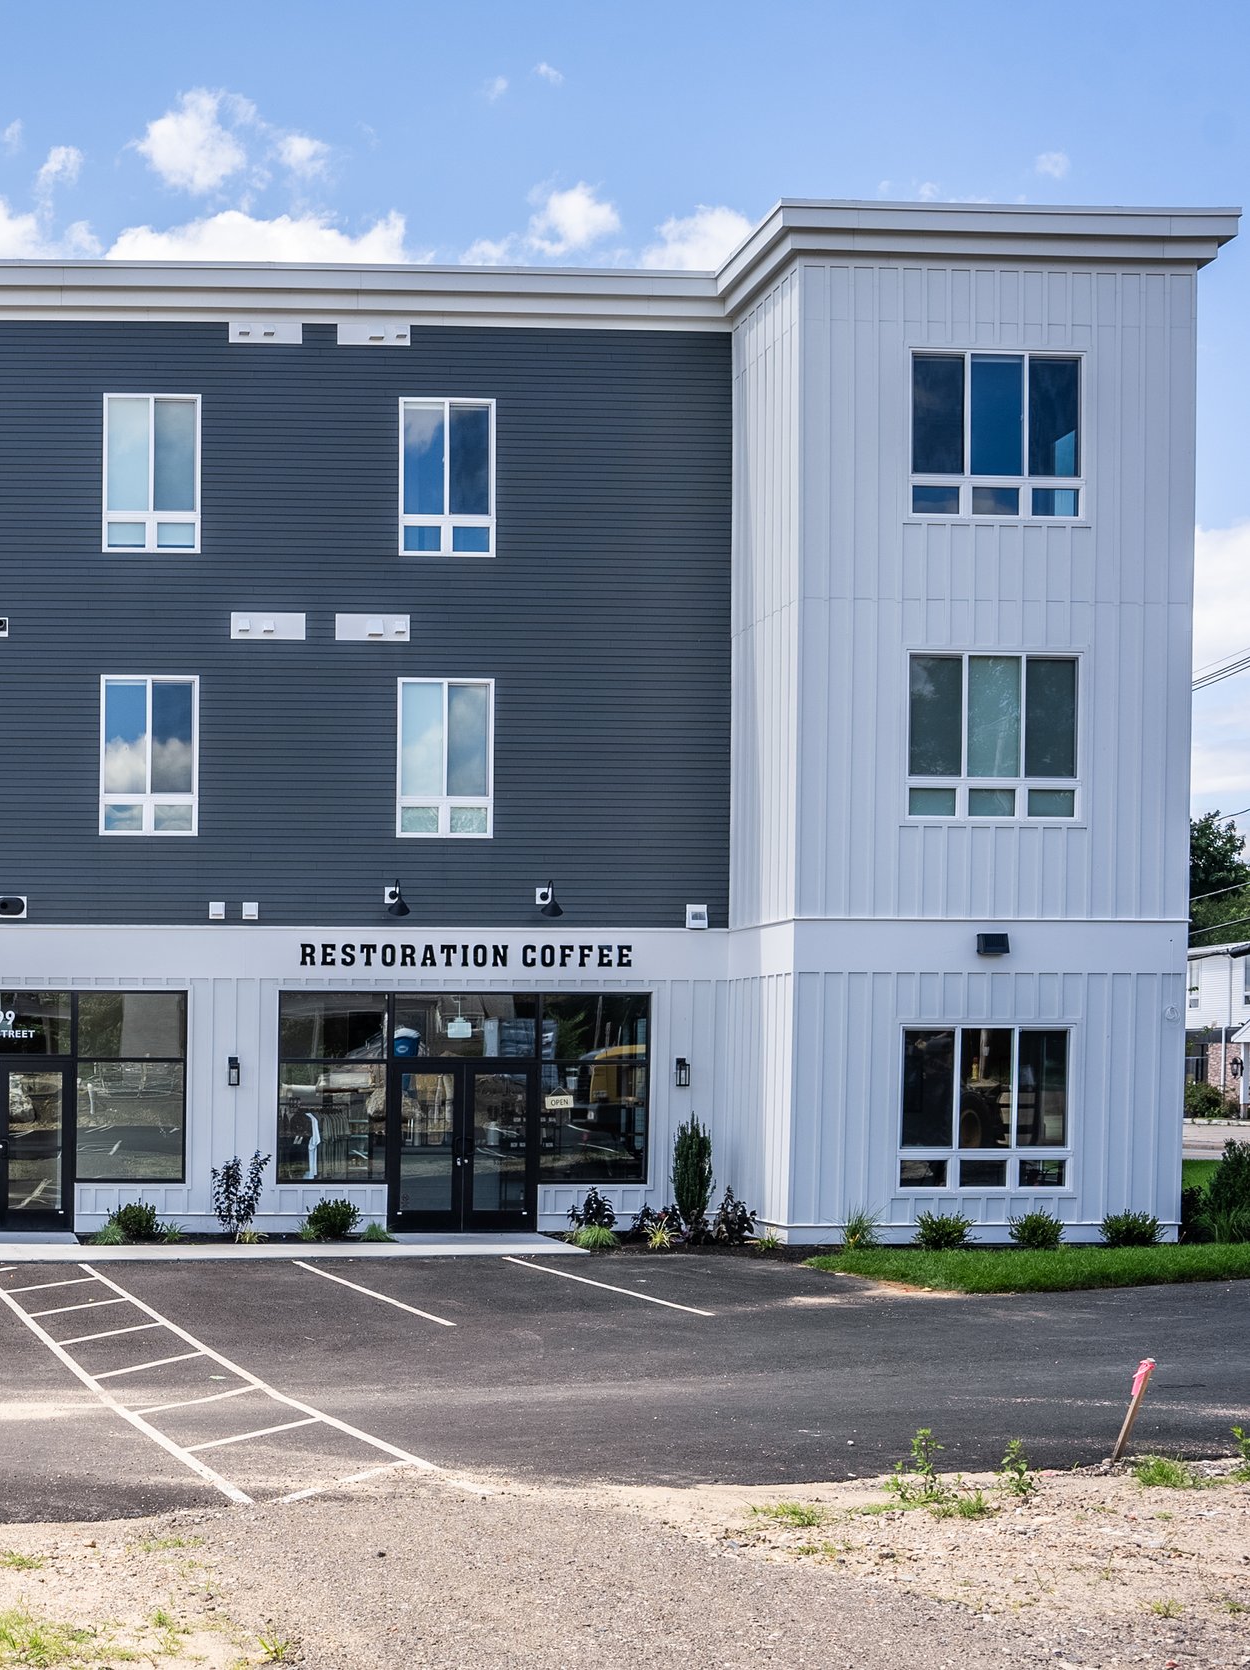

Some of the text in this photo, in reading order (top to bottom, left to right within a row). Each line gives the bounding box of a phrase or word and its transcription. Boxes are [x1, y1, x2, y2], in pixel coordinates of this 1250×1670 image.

[299, 943, 633, 968] RESTORATION COFFEE
[550, 1098, 569, 1106] OPEN
